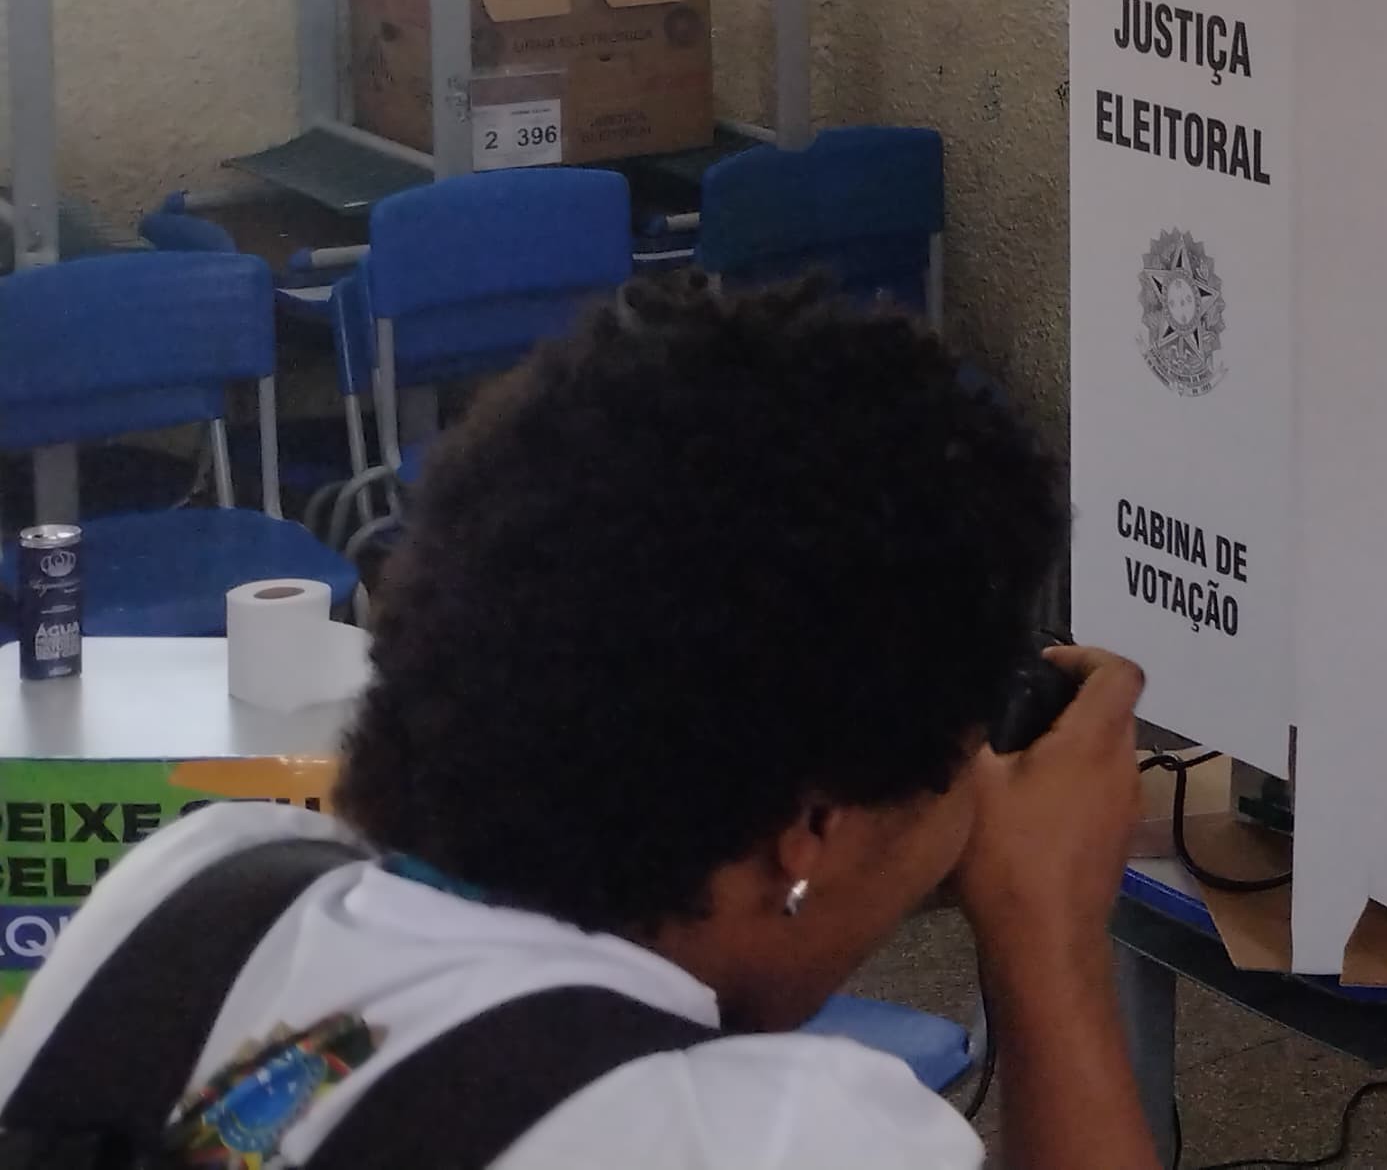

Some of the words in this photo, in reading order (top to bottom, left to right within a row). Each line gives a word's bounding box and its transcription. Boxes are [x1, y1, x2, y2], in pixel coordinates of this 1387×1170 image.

[485, 131, 499, 150] 2
[517, 125, 558, 147] 396
[1096, 90, 1270, 185] ELEITORAL
[1117, 498, 1206, 568] CABINA
[1216, 534, 1248, 583] DE
[1125, 556, 1238, 637] VOTAÇÃO
[0, 802, 162, 844] EIXE
